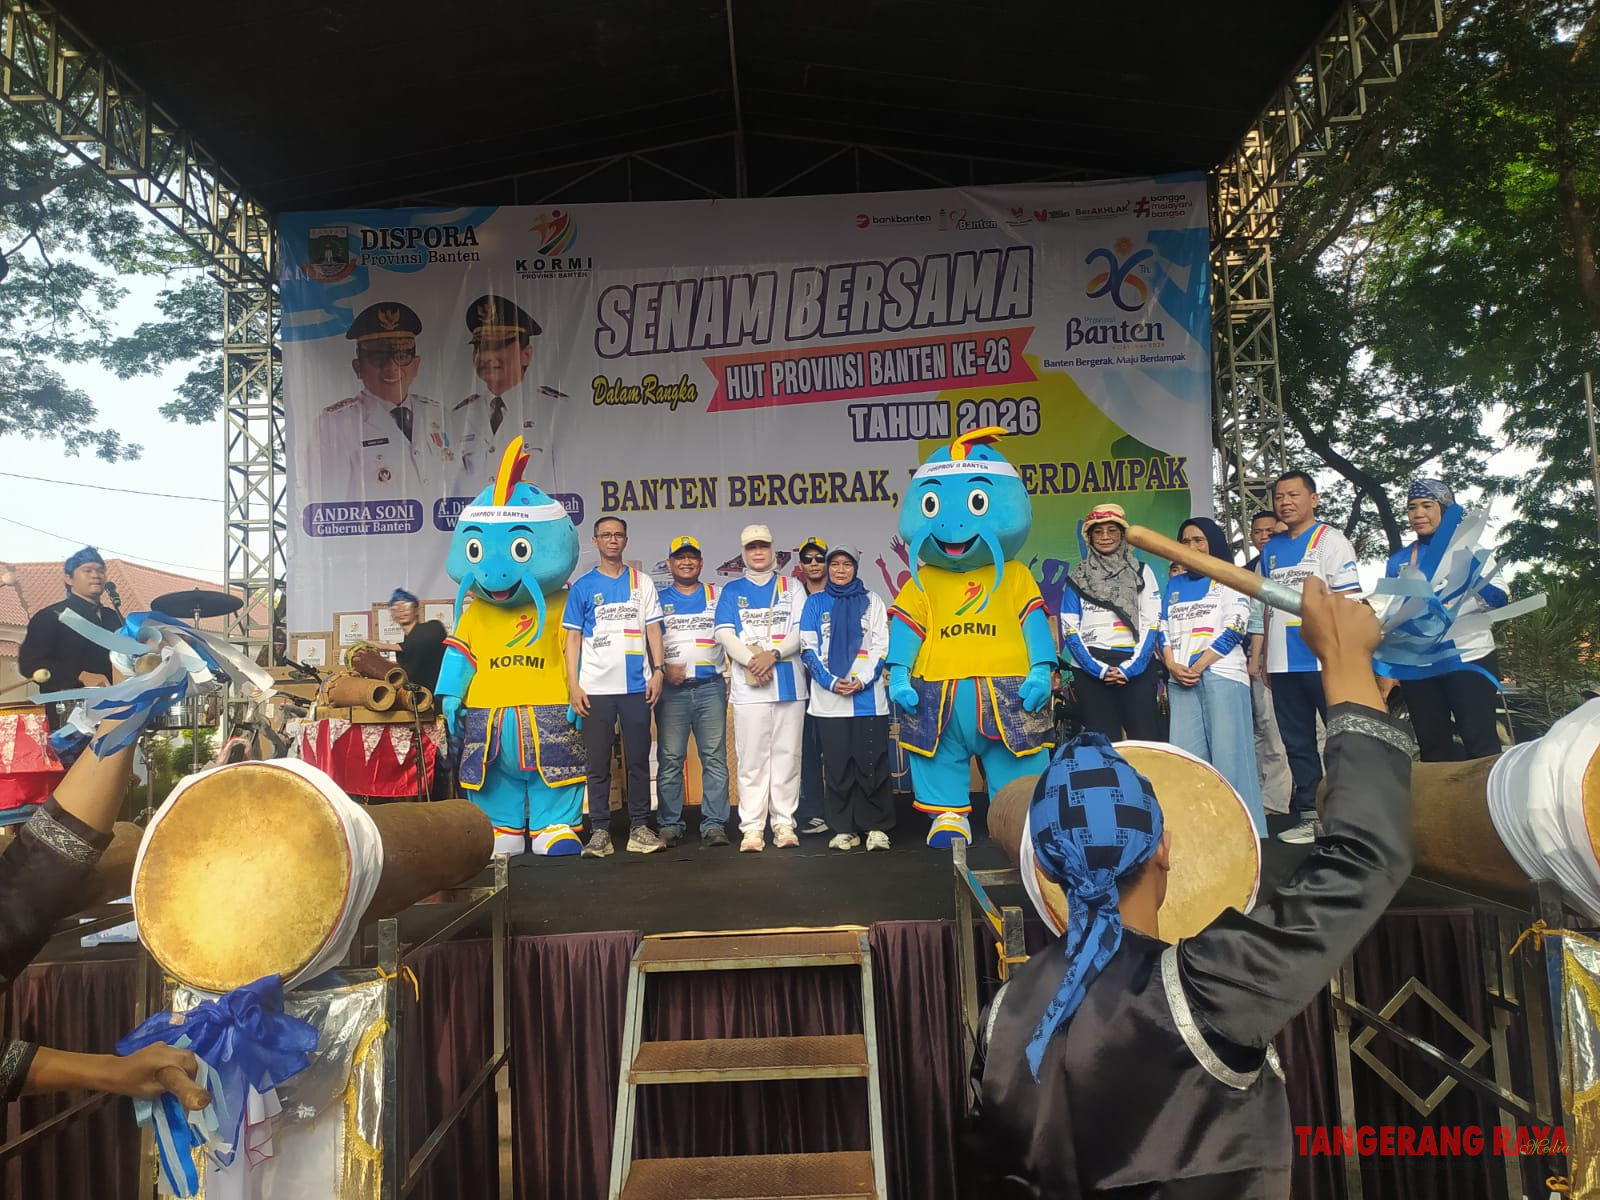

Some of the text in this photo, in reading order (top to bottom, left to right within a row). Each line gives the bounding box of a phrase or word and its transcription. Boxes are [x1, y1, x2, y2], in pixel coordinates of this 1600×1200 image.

[872, 214, 932, 224] bankbanten
[958, 219, 998, 230] Banten
[360, 225, 479, 251] DISPORA
[361, 251, 480, 266] Provinsi Banten
[515, 257, 592, 271] KORMI
[558, 271, 588, 279] BANTEN
[594, 245, 1034, 359] SENAM BERSAMA
[1065, 317, 1165, 352] Banten
[725, 337, 1011, 401] HUT PROVINSI BANTEN KE-26
[1043, 359, 1074, 369] Banten
[1116, 355, 1139, 365] Maju
[1140, 352, 1187, 363] Berdampak
[591, 374, 698, 411] Dalam Rangka
[849, 397, 1040, 442] TAHUN 2026
[600, 456, 1190, 512] BANTEN BERGERAK, ERDAMPAK
[313, 504, 415, 522] ANDRA SONI
[317, 520, 412, 535] Gubernur Banten
[940, 622, 997, 640] KORMI
[490, 654, 545, 670] KORMI
